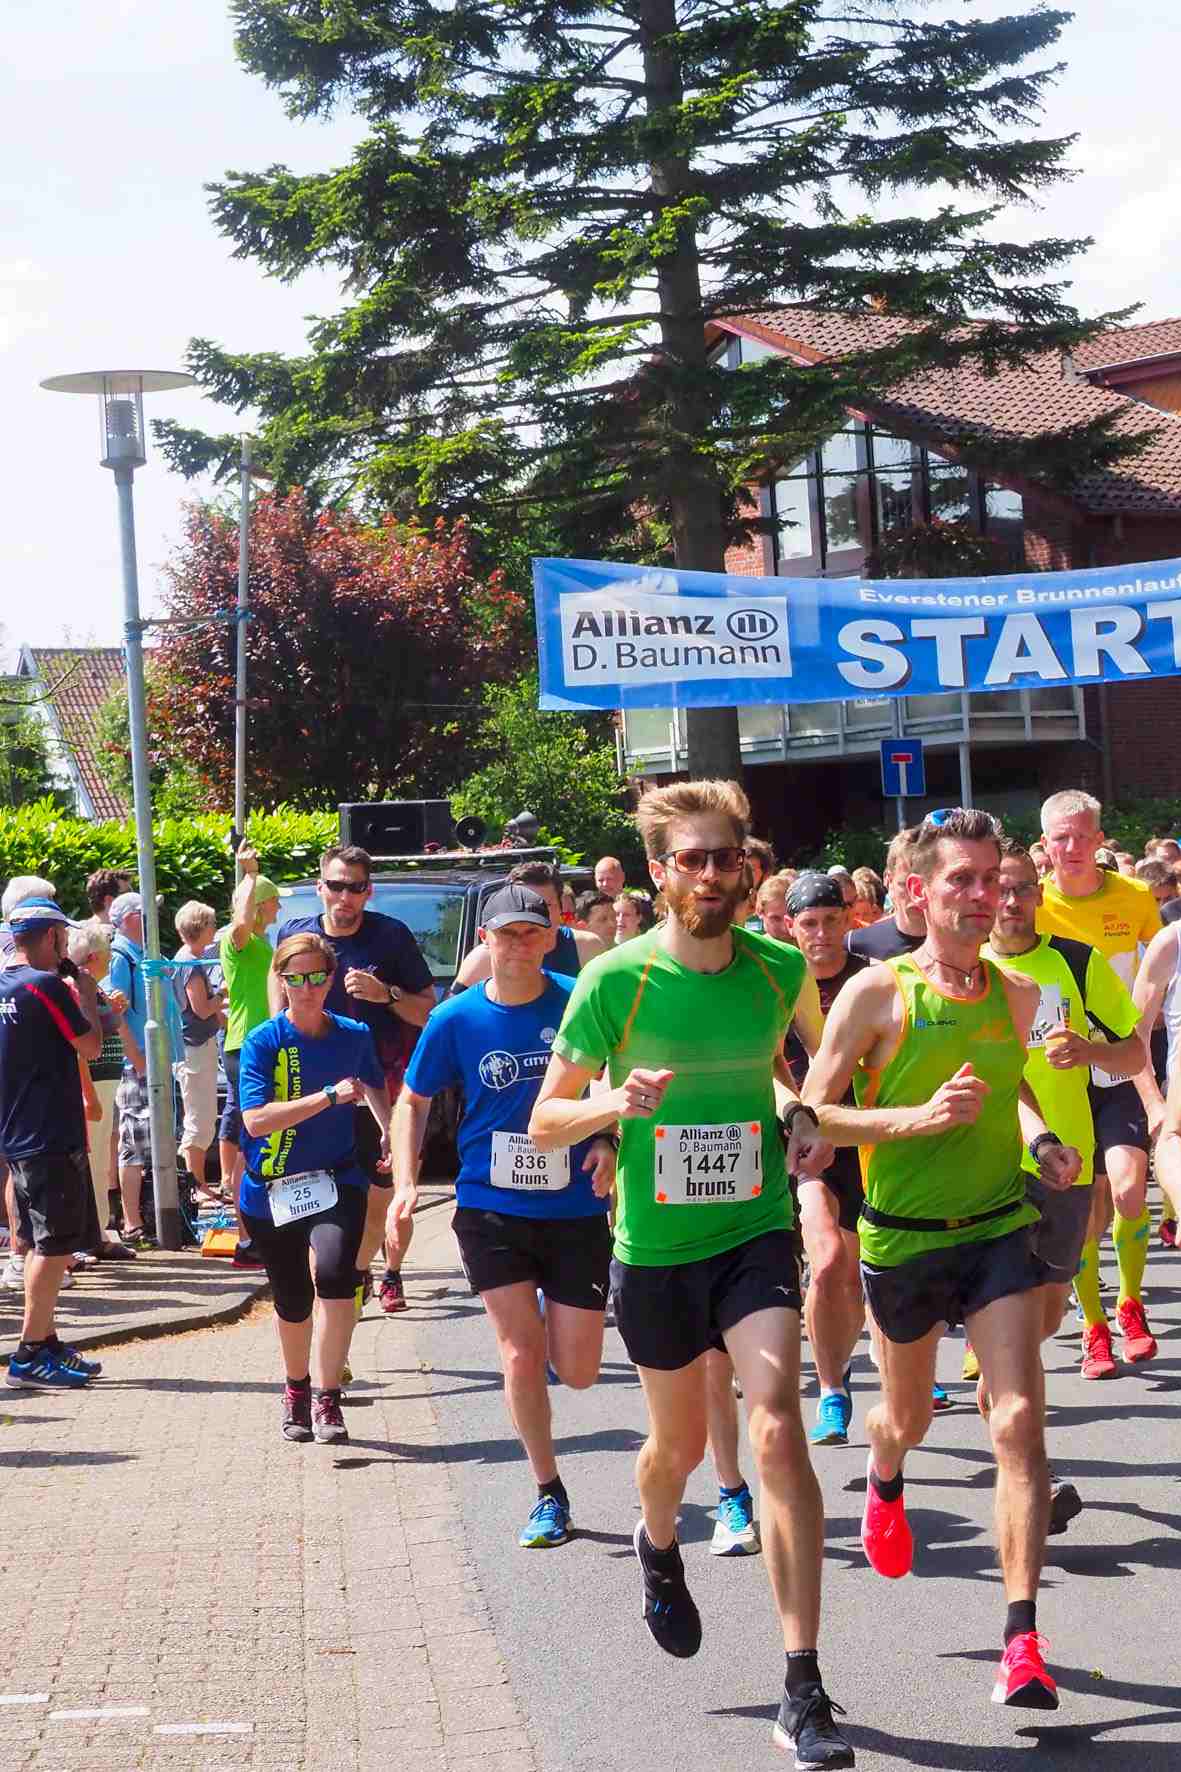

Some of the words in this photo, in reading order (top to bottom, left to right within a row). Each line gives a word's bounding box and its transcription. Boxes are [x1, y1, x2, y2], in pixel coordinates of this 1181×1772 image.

[859, 588, 1008, 607] Everstener
[570, 609, 716, 640] Allianz
[572, 644, 607, 671] D.
[616, 643, 782, 669] Baumann
[288, 1046, 300, 1074] 2018
[523, 1055, 551, 1067] CITYL
[508, 1135, 532, 1145] Allia
[680, 1128, 724, 1140] Allianz
[693, 1141, 742, 1153] Baumann
[514, 1154, 547, 1169] 836
[682, 1153, 740, 1174] 1447
[511, 1170, 549, 1185] bruns
[294, 1187, 312, 1201] 25
[686, 1177, 736, 1196] bruns
